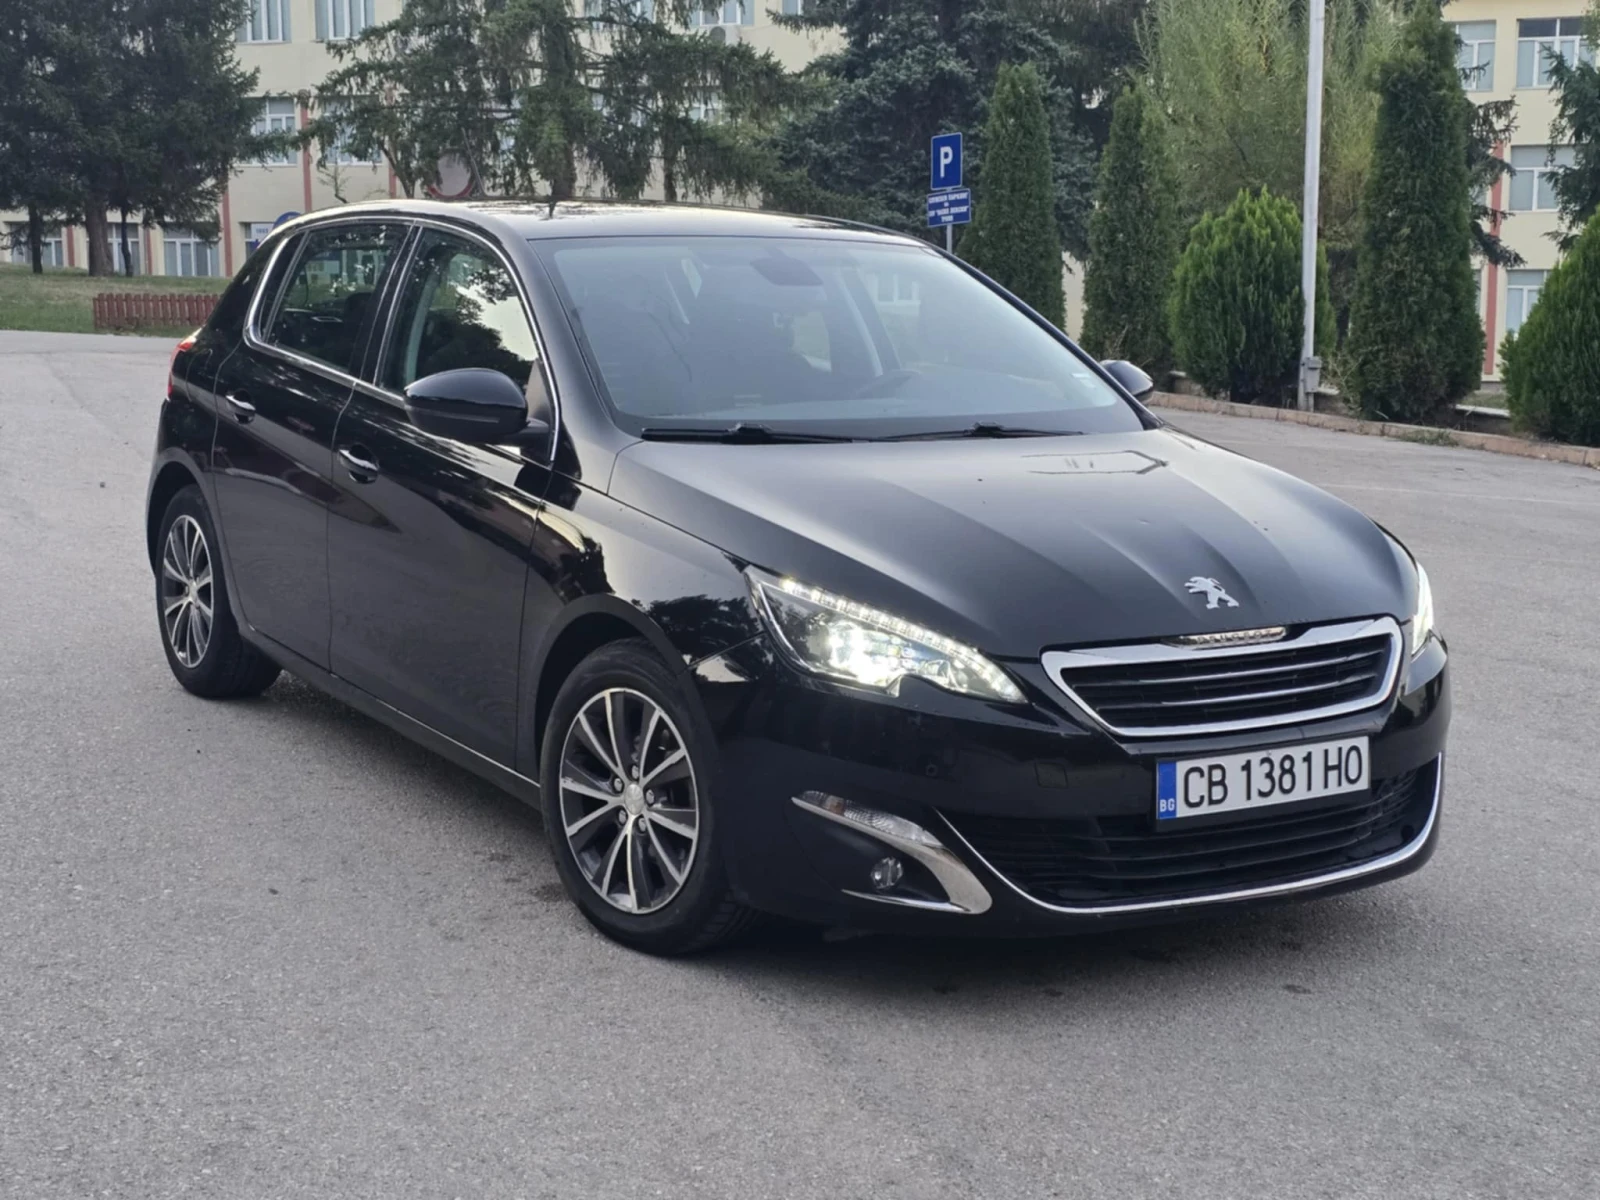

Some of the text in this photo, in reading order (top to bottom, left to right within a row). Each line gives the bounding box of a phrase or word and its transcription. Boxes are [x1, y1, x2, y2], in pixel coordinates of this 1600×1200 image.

[940, 146, 953, 178] P
[1241, 751, 1313, 801] 1381
[1159, 798, 1175, 812] BG
